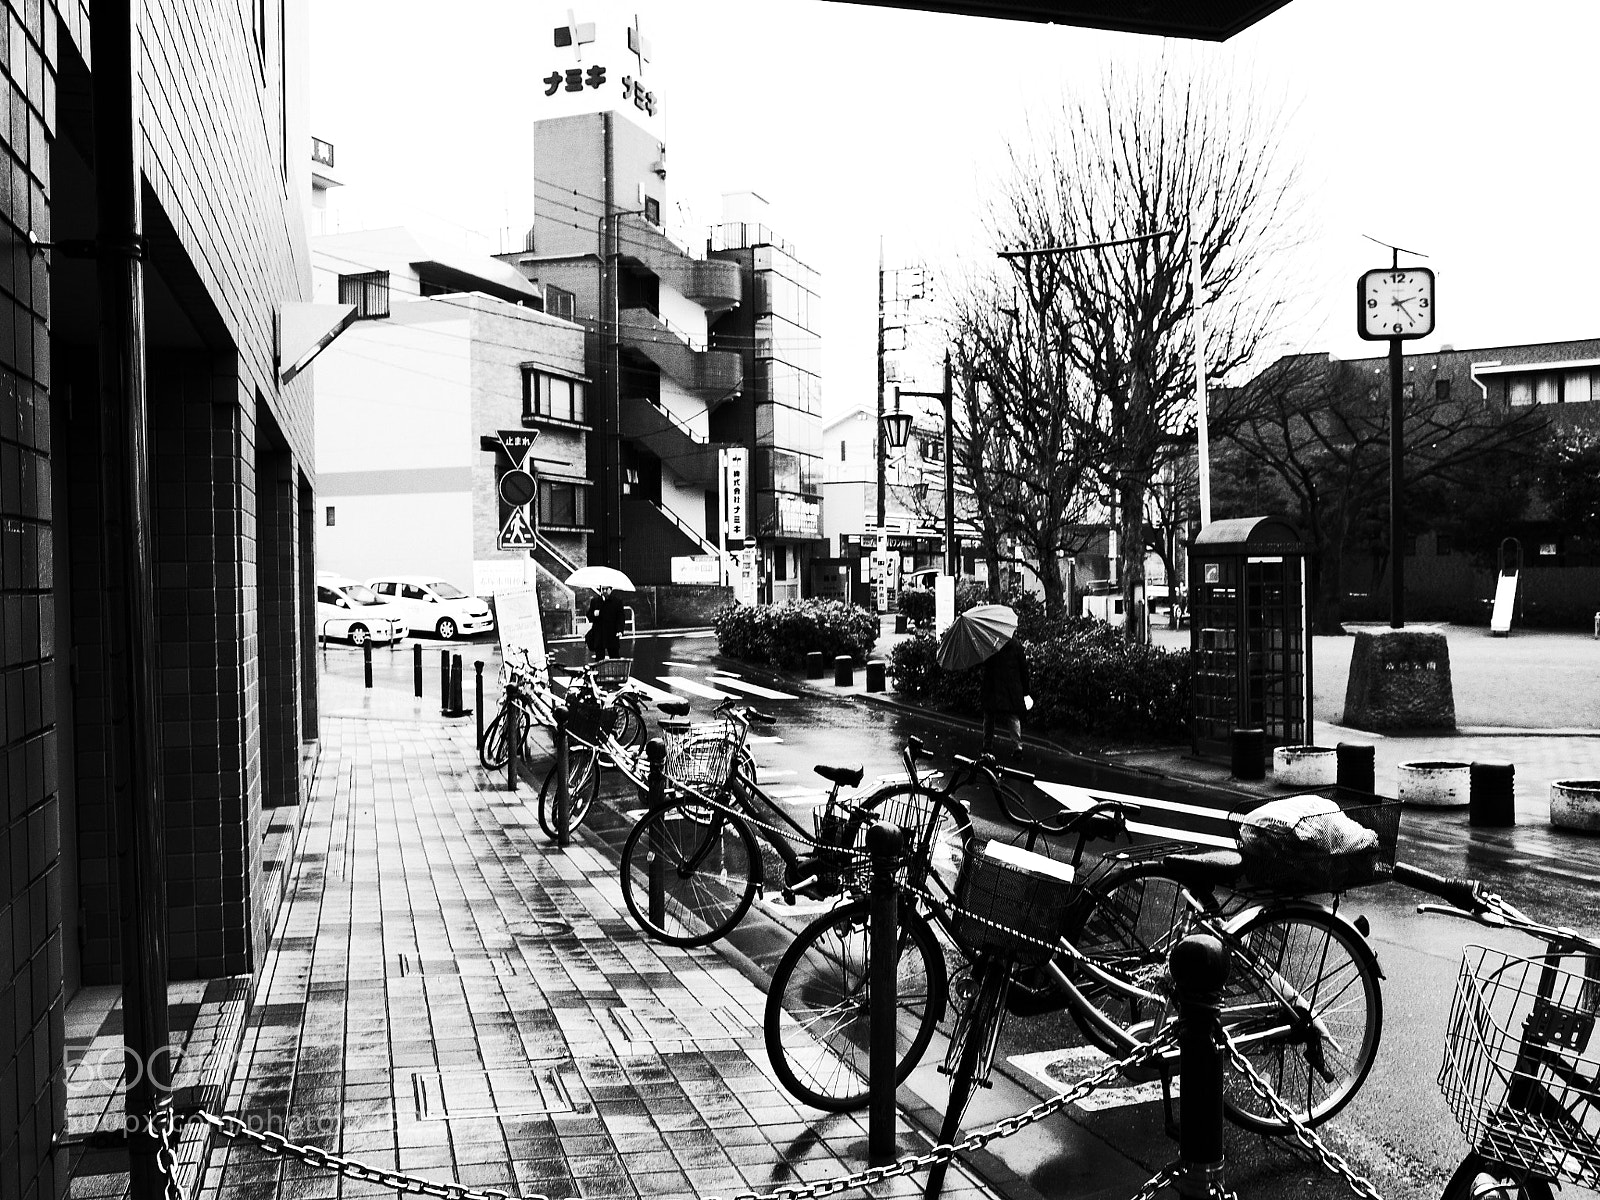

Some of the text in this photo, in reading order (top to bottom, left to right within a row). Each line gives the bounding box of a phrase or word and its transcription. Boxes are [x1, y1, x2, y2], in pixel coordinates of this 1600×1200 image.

[543, 65, 606, 96] ナミキ
[622, 75, 657, 117] ナミキ
[1390, 273, 1406, 284] 12
[1367, 298, 1378, 309] 9
[1419, 298, 1429, 308] 3
[1392, 323, 1403, 334] 6
[505, 436, 530, 446] 止まれ
